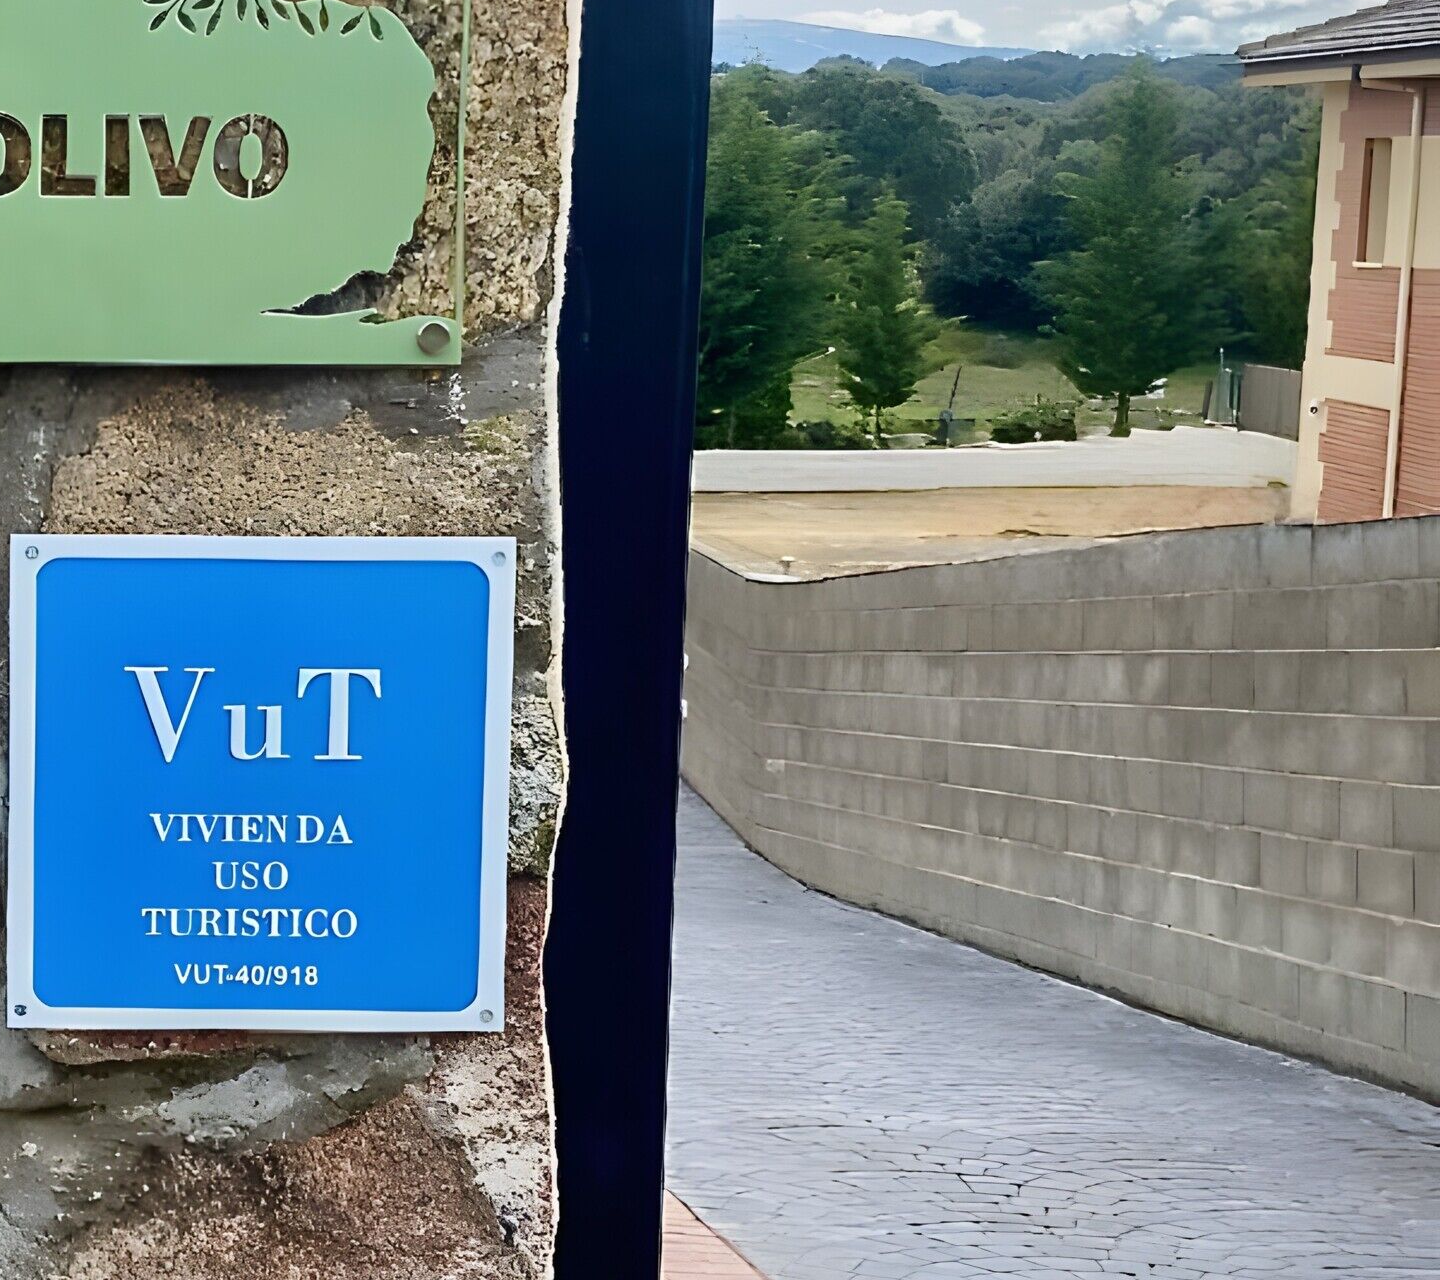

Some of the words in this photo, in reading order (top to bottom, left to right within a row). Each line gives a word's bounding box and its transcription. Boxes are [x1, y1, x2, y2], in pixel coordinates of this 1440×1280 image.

[124, 666, 382, 763] VuT
[149, 813, 353, 844] VIVIENDA
[212, 861, 289, 890] USO
[141, 908, 358, 938] TURISTICO
[173, 963, 319, 987] VUT-40/918
